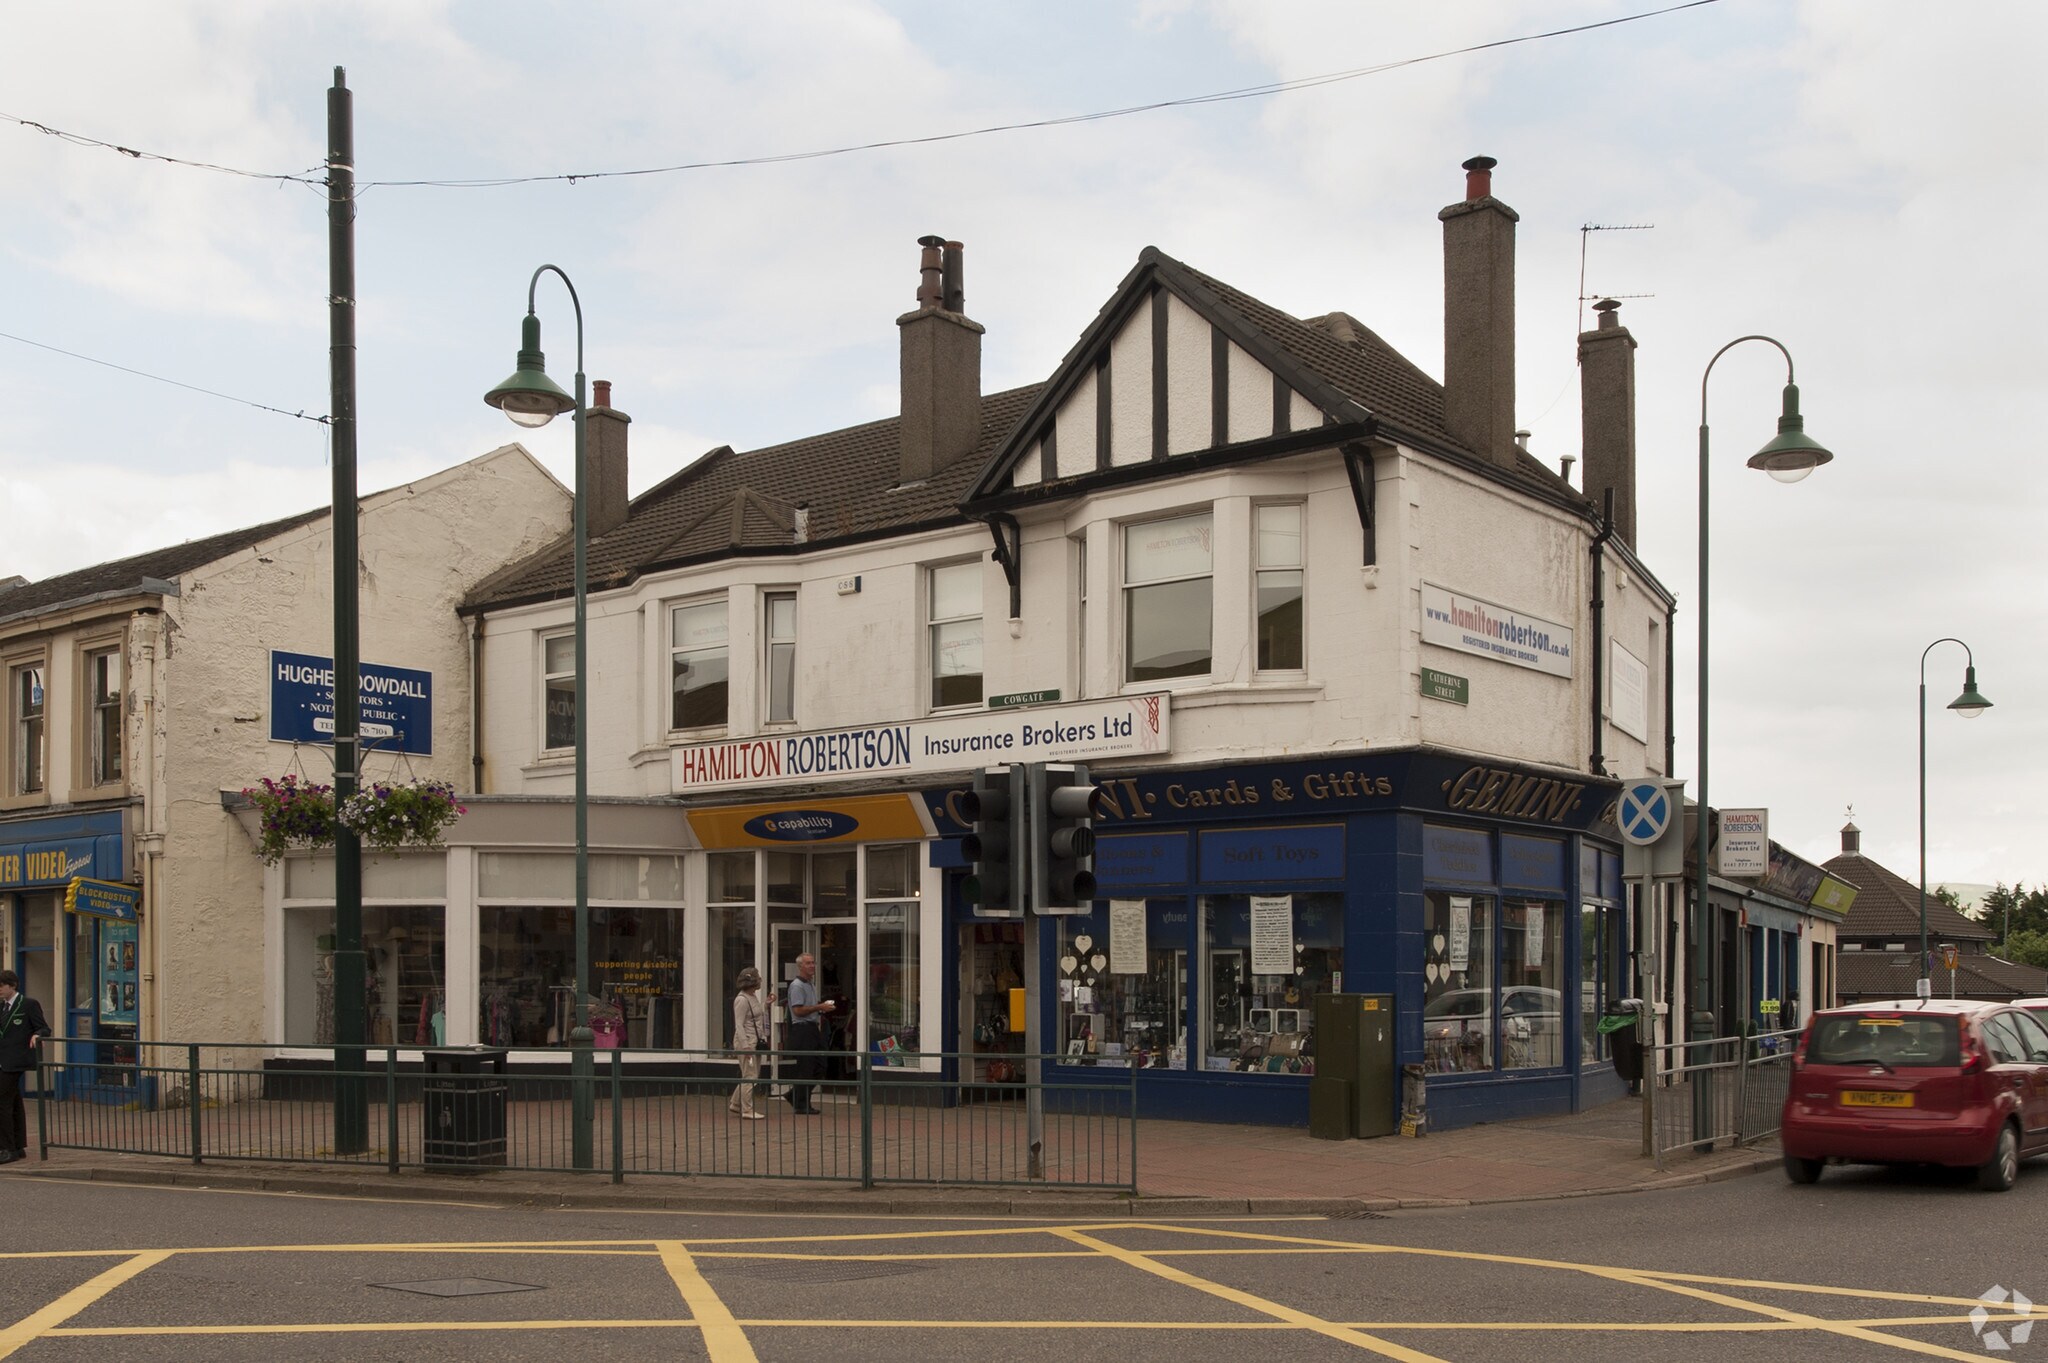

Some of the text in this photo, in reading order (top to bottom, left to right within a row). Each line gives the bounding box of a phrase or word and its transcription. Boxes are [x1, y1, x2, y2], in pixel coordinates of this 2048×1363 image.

[1426, 597, 1570, 657] www.hamiltonrobertson.co.uk
[1462, 634, 1538, 663] REGISTERED INSURANCE BROKERS
[278, 663, 426, 698] HUGHE OWDALL
[1429, 672, 1461, 689] CATHERINE
[1003, 693, 1045, 705] COWGATE
[1434, 686, 1456, 699] STREET
[362, 708, 398, 721] PUBLIC
[683, 713, 1133, 784] HAMILTON ROBERTSON Insurance Brokers Ltd
[1049, 748, 1078, 756] REGISTERED
[1079, 745, 1108, 753] INSURANCE
[1166, 780, 1260, 810] Cards
[1272, 779, 1295, 802] &
[1303, 771, 1393, 801] Gifts
[1448, 766, 1585, 823] GEMINI
[777, 816, 833, 831] capability
[1726, 814, 1760, 823] HAMILTON
[1723, 823, 1762, 832] ROBERTSON
[1223, 844, 1320, 865] Soft Toys
[26, 851, 66, 881] VIDEO
[79, 886, 132, 904] BLOCKBUSTER
[90, 899, 112, 909] VIDEO
[594, 960, 679, 970] supporting disabled
[623, 972, 653, 981] people
[625, 985, 661, 994] Scotland
